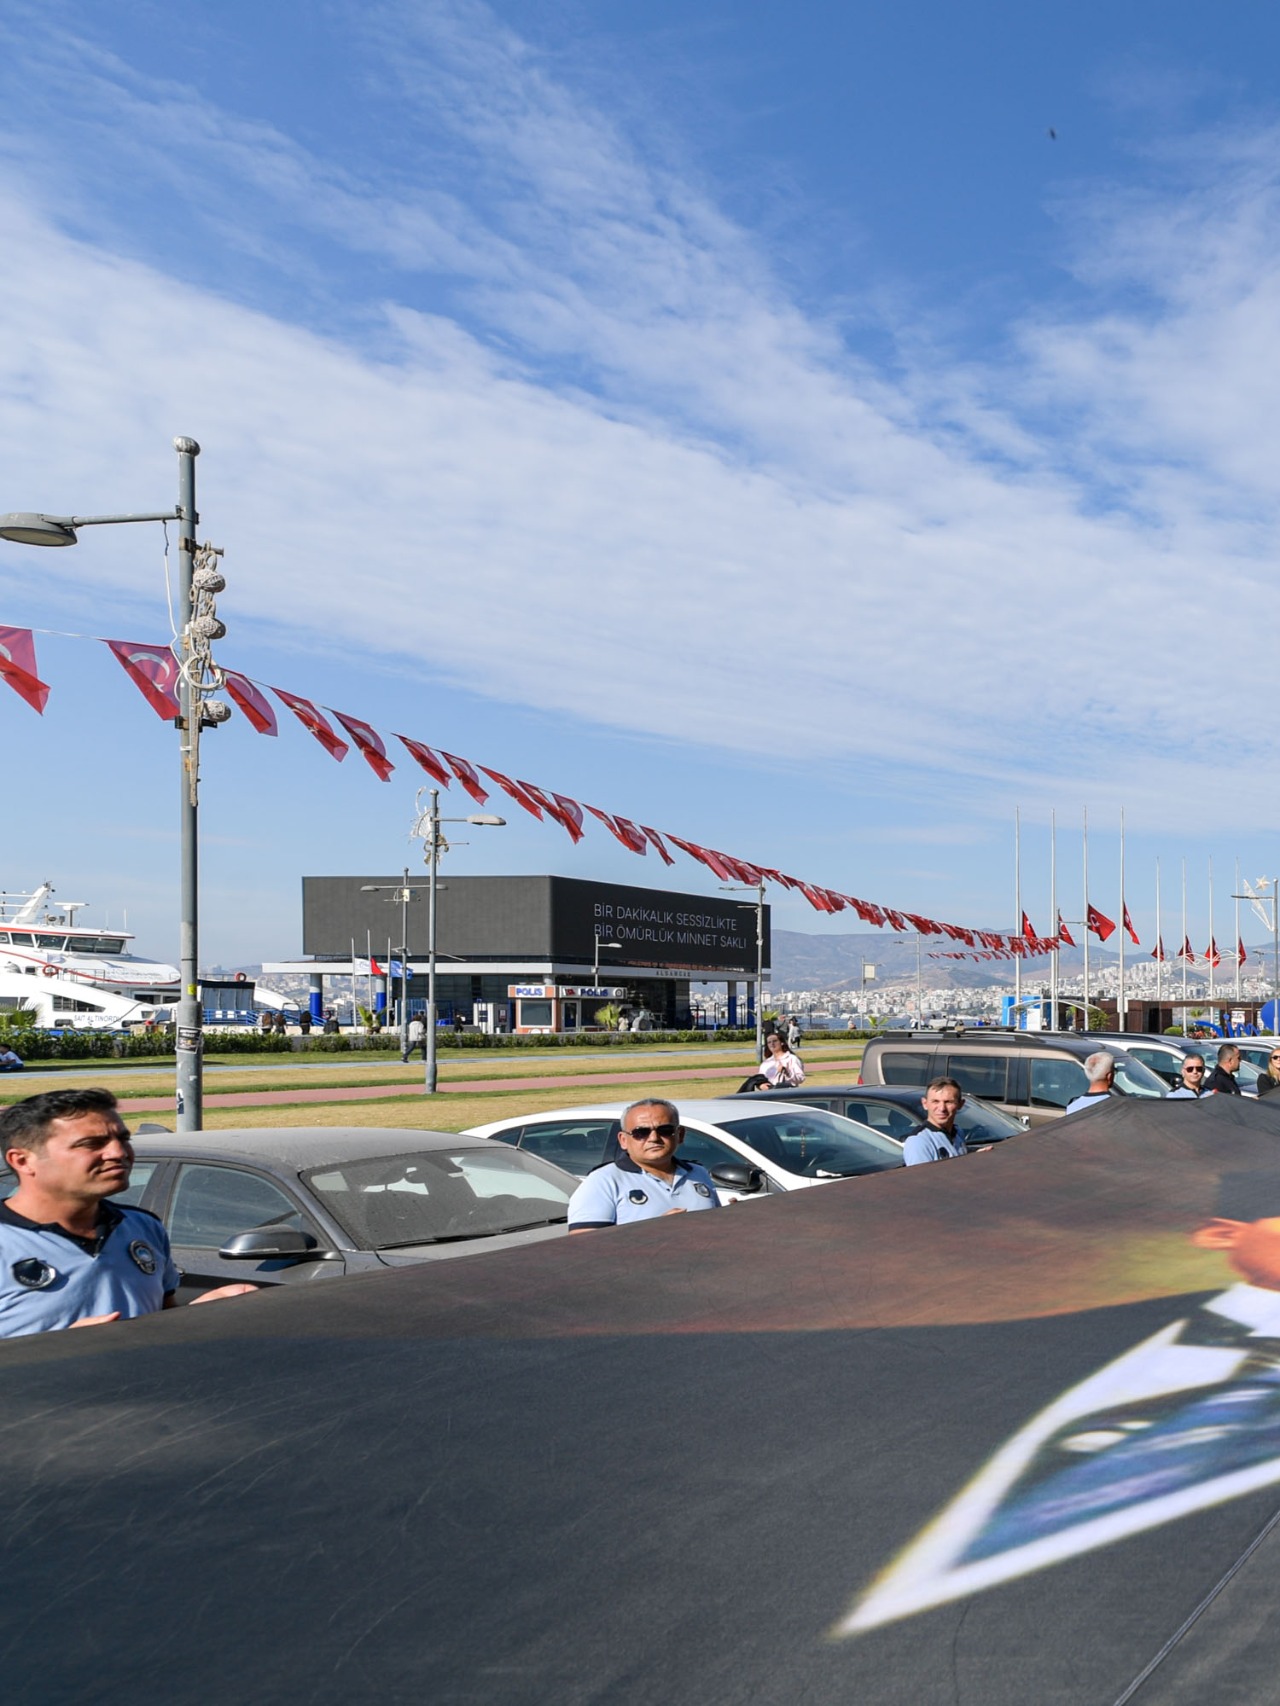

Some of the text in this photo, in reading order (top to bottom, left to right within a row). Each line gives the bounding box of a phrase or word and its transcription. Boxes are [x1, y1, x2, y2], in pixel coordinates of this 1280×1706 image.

[594, 903, 737, 931] BİR DAKİKALIK SESSİZLİKTE
[594, 923, 747, 949] BİR ÖMÜRLÜK MİNNET SAKLI
